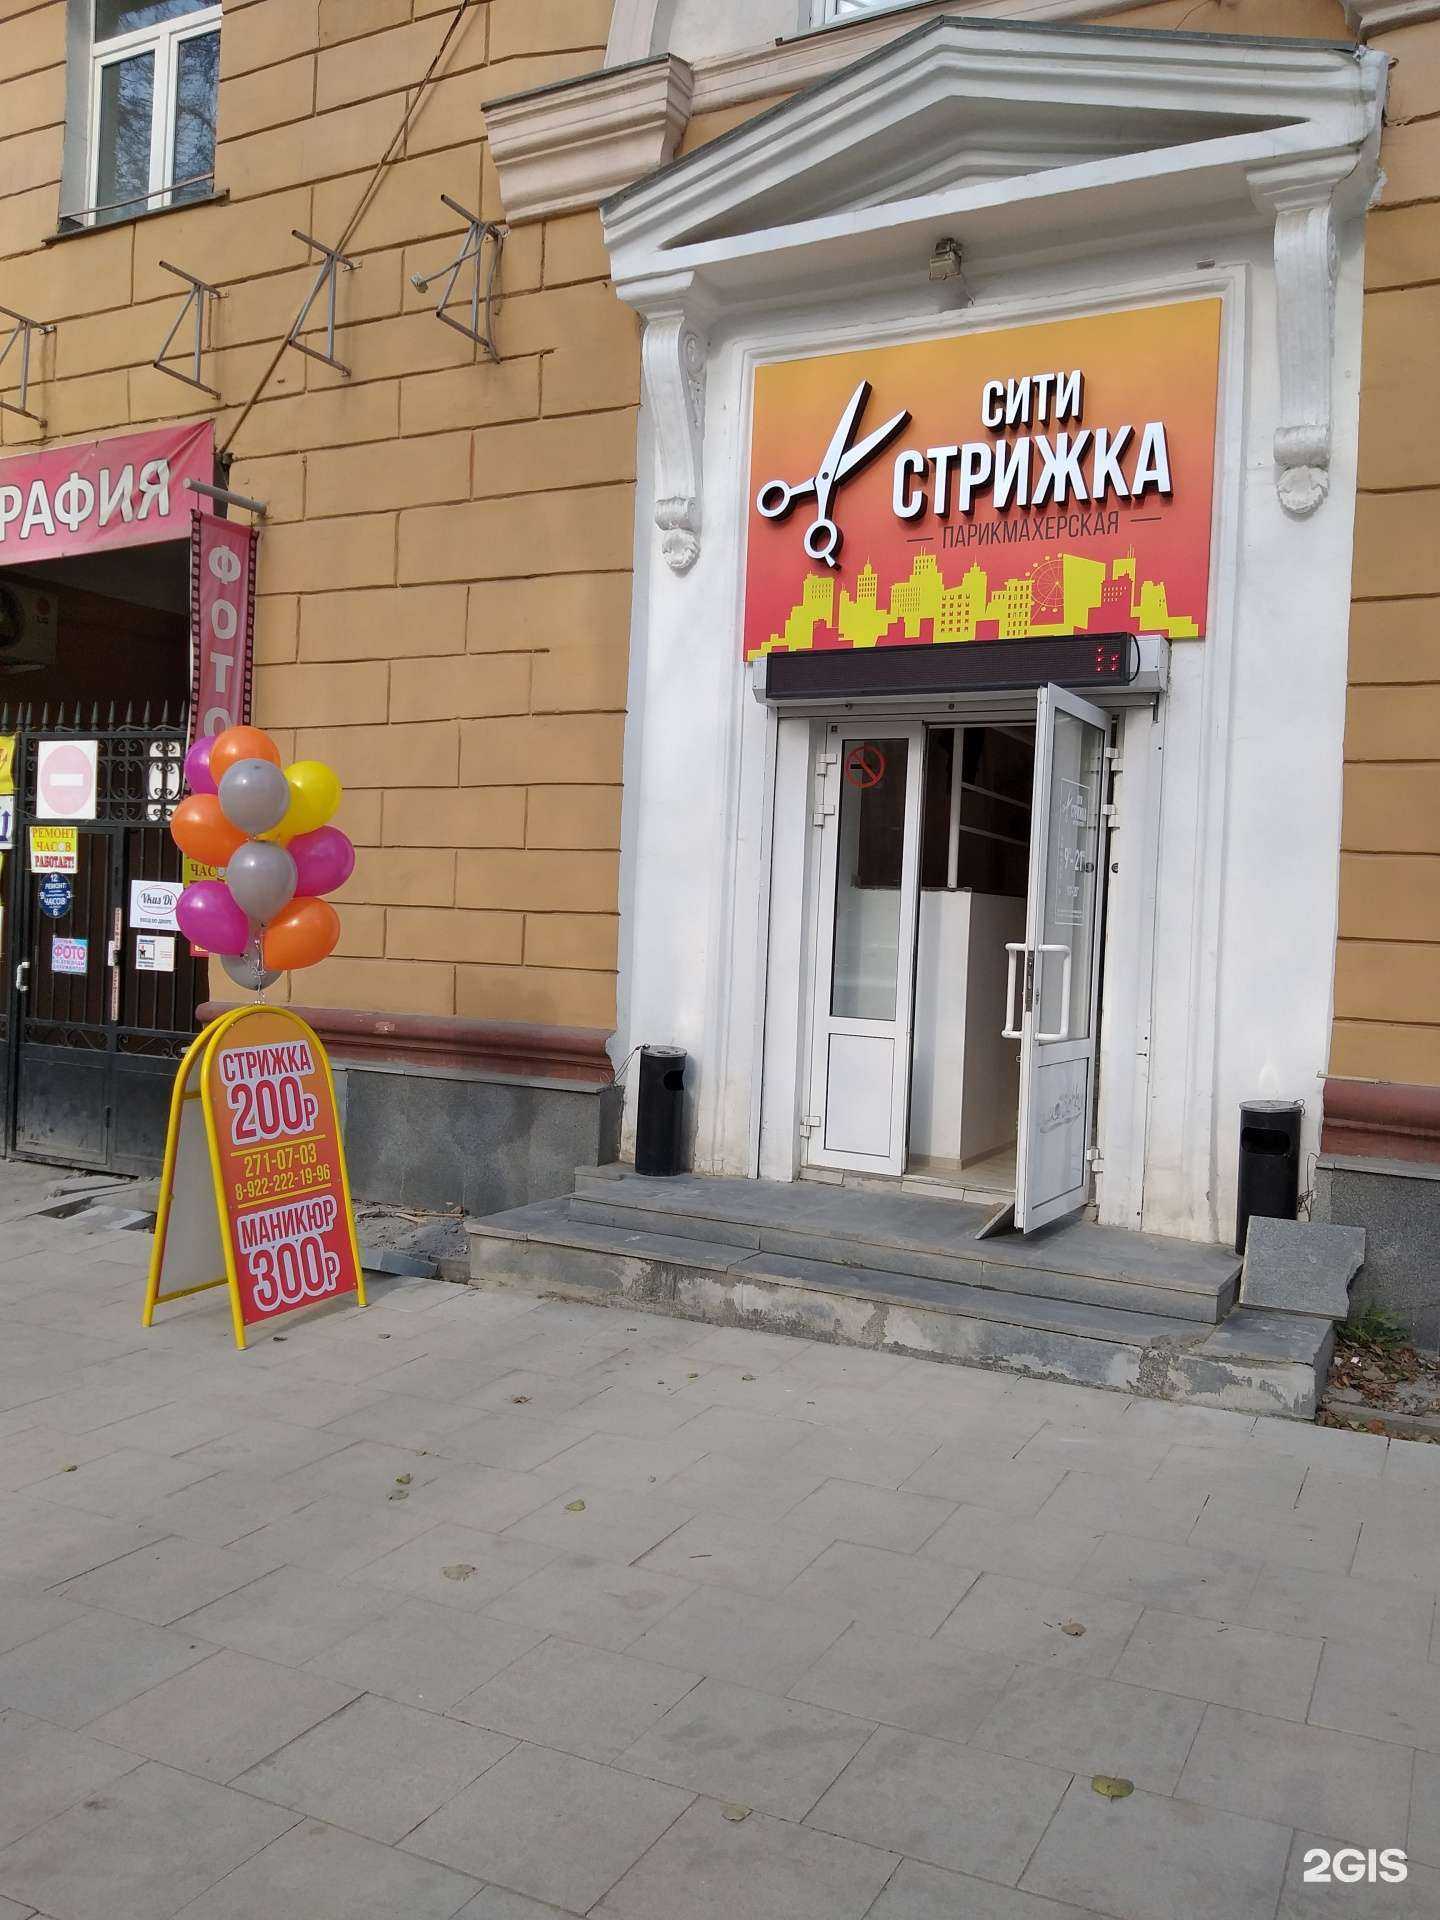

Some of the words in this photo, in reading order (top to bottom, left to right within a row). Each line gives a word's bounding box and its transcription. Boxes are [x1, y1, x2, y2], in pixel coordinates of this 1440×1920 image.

[981, 369, 1084, 430] СИТИ
[892, 421, 1172, 519] СТРИЖКА
[942, 511, 1119, 549] ПАРИКМАХЕРСКАЯ
[31, 828, 75, 838] РЕМОНТ
[34, 855, 75, 868] РАБОТАЕТ!
[50, 874, 58, 882] 12
[44, 897, 66, 906] ЧАСОВ
[54, 944, 85, 960] ФОТО
[222, 1044, 312, 1082] СТРИЖКА
[243, 1144, 318, 1178] 271-07-03
[235, 1163, 331, 1201] 8-922-222-19-96
[241, 1199, 334, 1249] МАНИКЮР
